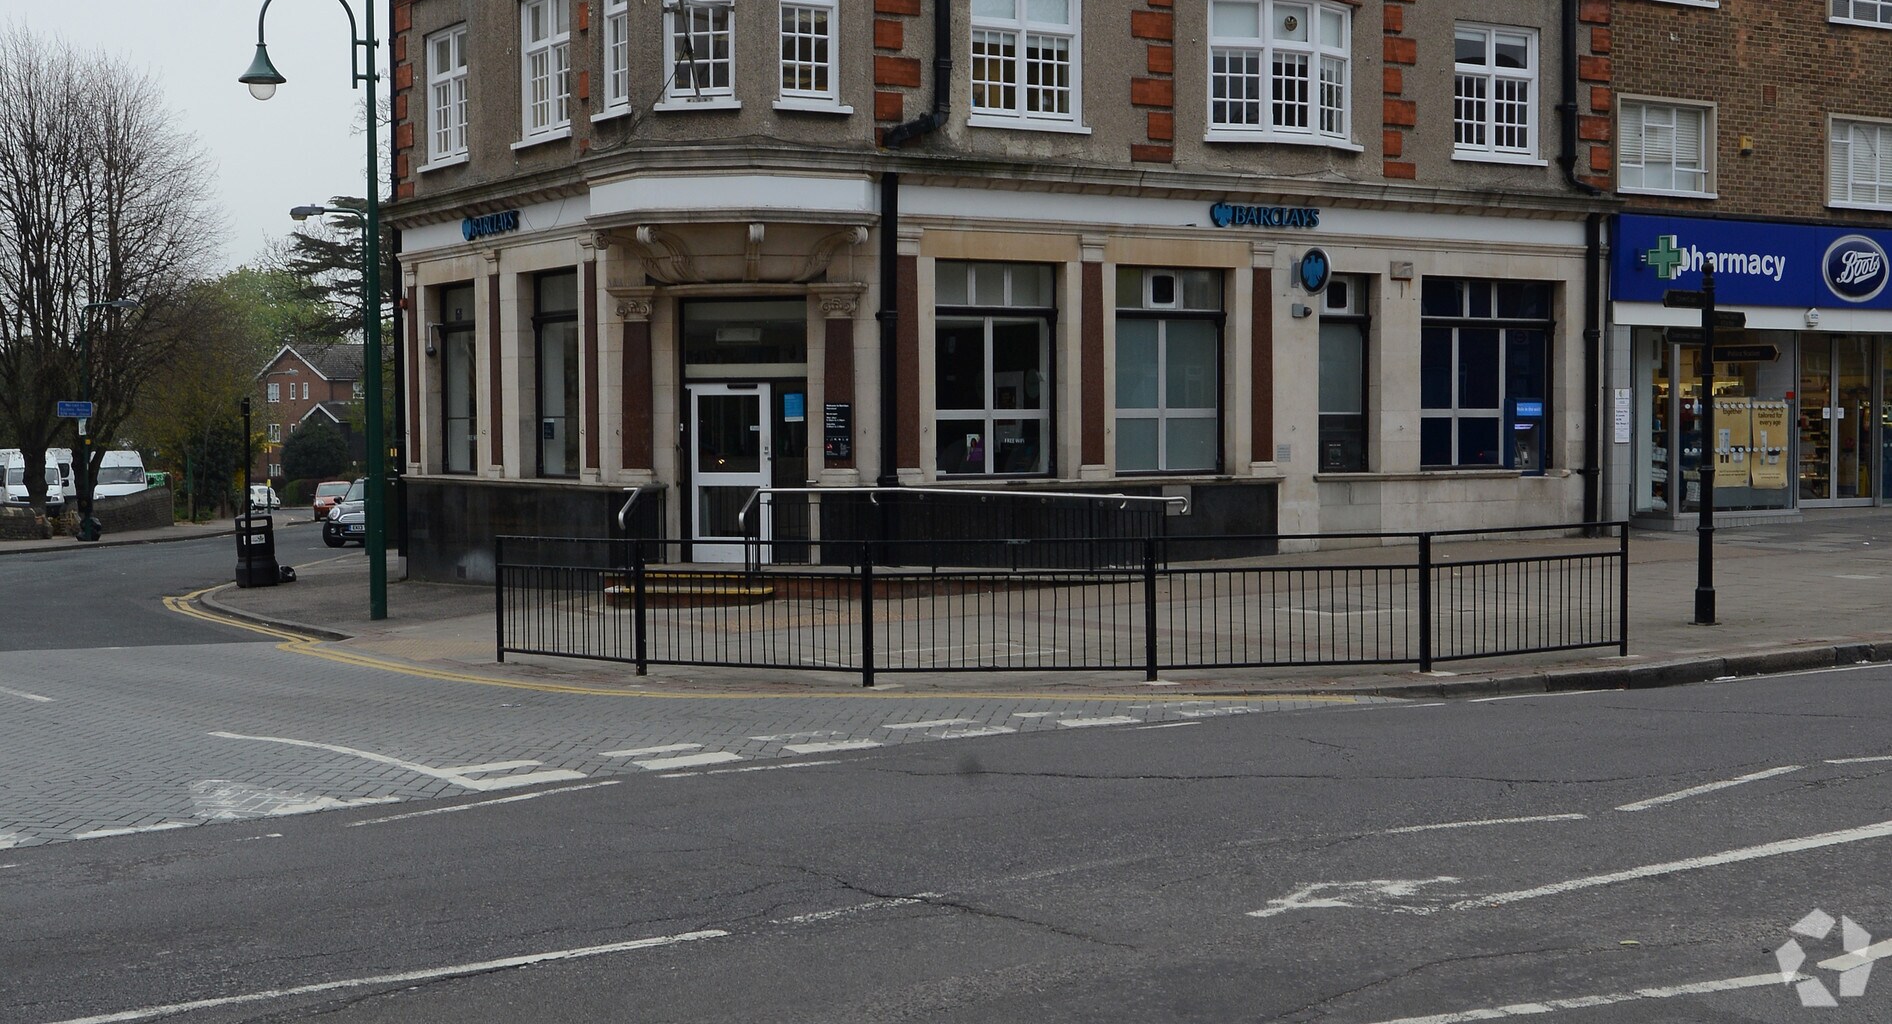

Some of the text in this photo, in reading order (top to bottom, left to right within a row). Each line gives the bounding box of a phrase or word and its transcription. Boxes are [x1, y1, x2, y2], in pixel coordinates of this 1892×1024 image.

[472, 211, 517, 237] BARCLAYS
[1234, 205, 1320, 228] BARCLAYS
[1836, 250, 1881, 284] Boots
